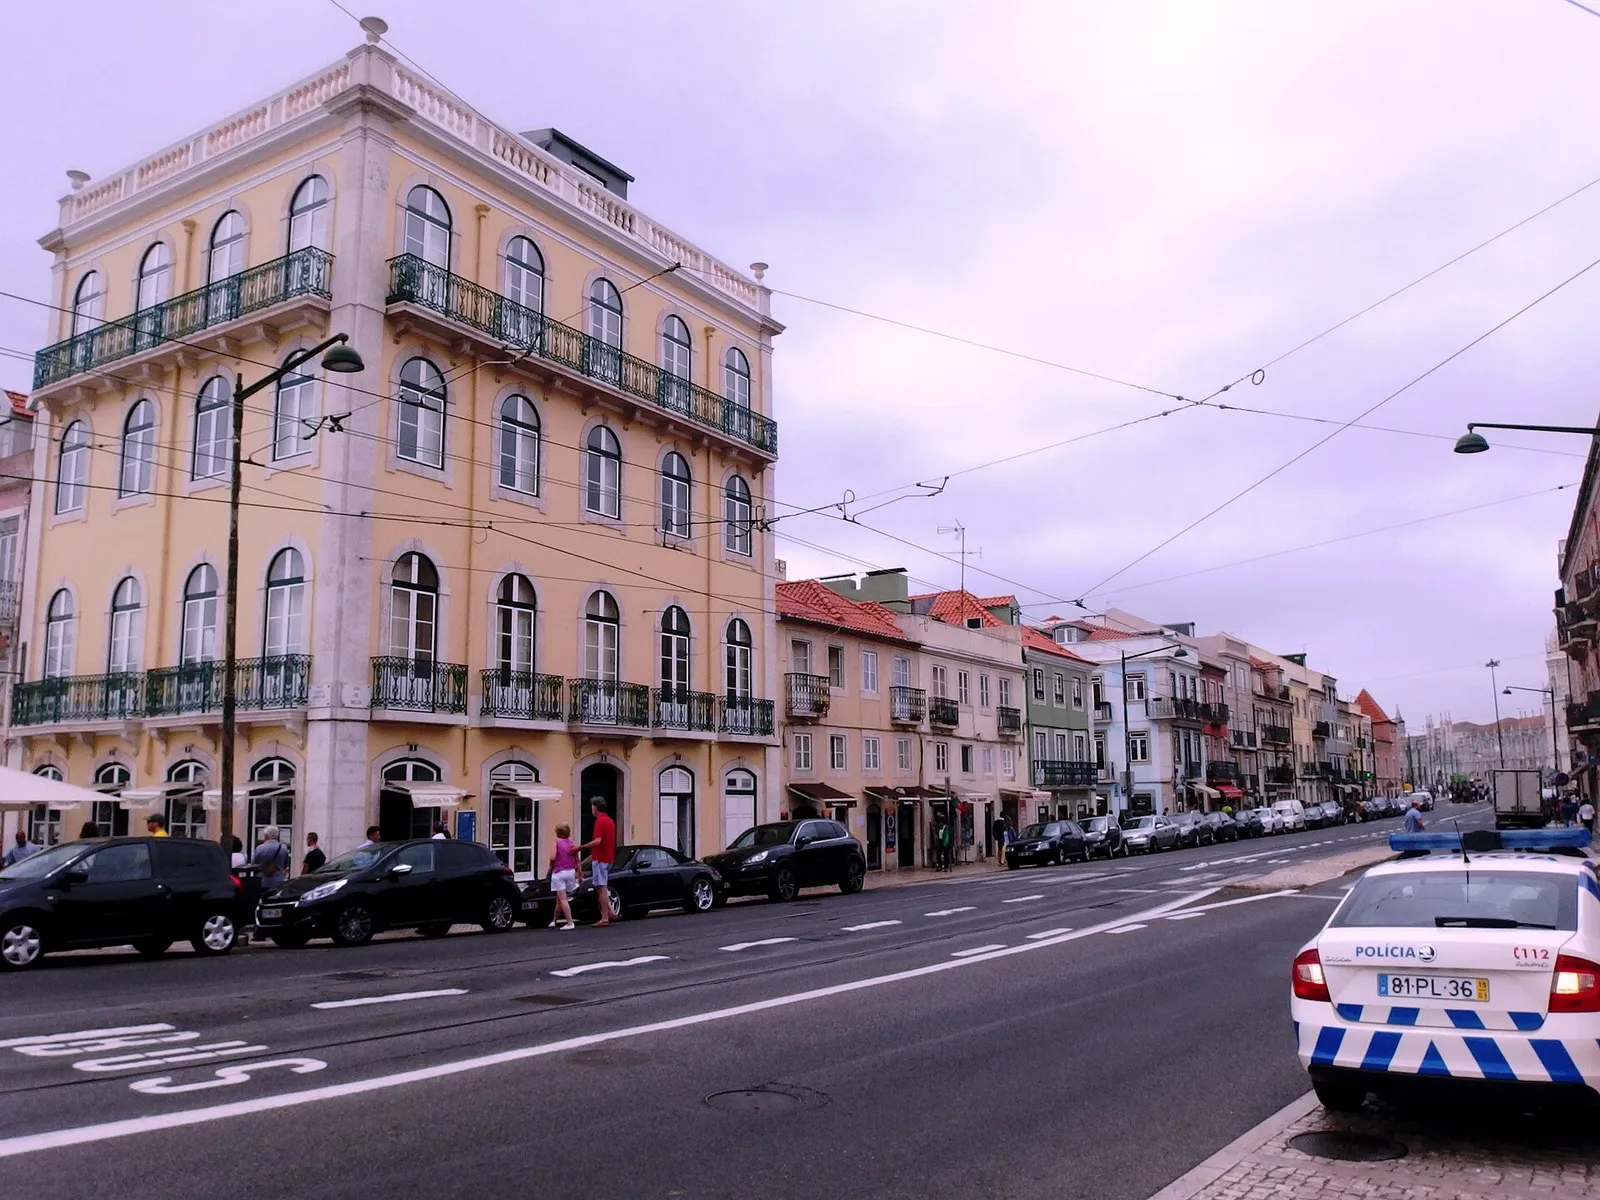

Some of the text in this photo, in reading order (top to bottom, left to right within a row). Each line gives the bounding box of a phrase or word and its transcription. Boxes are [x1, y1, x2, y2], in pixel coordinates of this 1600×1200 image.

[1355, 943, 1416, 958] POLÍCIA
[1522, 948, 1550, 960] 112
[0, 1023, 328, 1094] BUS
